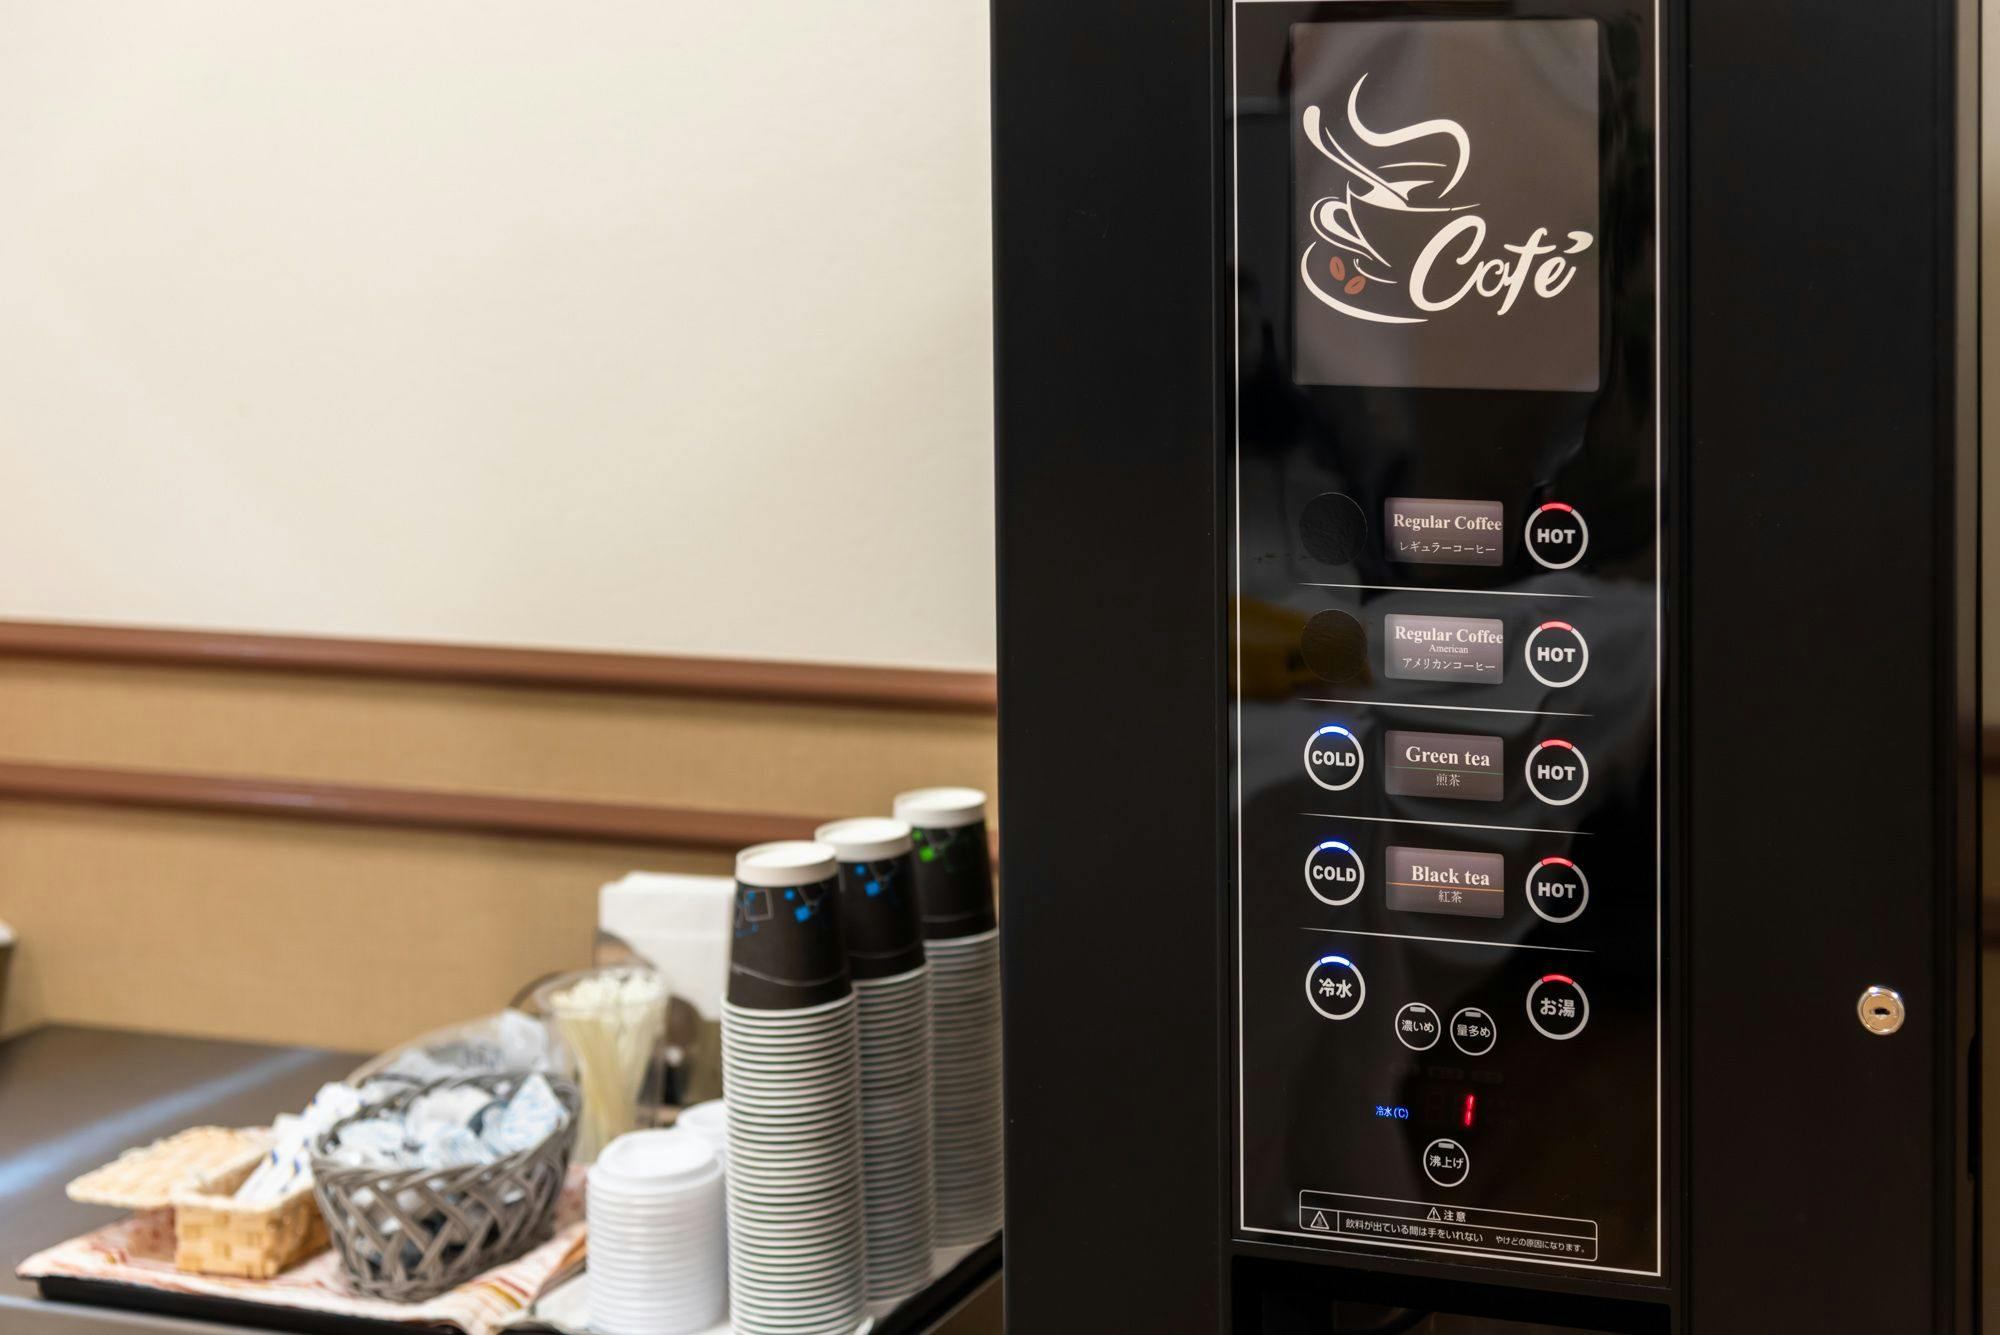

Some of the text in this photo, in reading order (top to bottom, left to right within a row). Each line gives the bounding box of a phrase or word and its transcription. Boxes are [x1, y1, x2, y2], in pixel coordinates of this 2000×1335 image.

[1409, 215, 1594, 316] Café
[1393, 513, 1503, 532] Regular Coffee
[1537, 529, 1576, 545] HOT
[1400, 541, 1496, 554] レギュラーコーヒー
[1395, 626, 1503, 644] Regular Coffee
[1429, 644, 1469, 654] American
[1537, 647, 1576, 664] HOT
[1402, 658, 1496, 671] アメリカンコーヒー
[1312, 750, 1356, 767] COLD
[1405, 745, 1490, 767] Green tea
[1435, 773, 1461, 788] 煎茶
[1537, 765, 1576, 782] HOT
[1312, 865, 1357, 882] COLD
[1411, 865, 1490, 886] Black tea
[1438, 890, 1463, 904] 紅茶
[1538, 882, 1576, 899] HOT
[1318, 978, 1353, 999] 冷水
[1539, 998, 1576, 1019] お湯
[1401, 1019, 1435, 1033] 濃いめ
[1456, 1024, 1491, 1038] 量多め
[1429, 1155, 1464, 1169] 沸上げ
[1345, 1218, 1484, 1242] 飲料が出ている間は手をいれない
